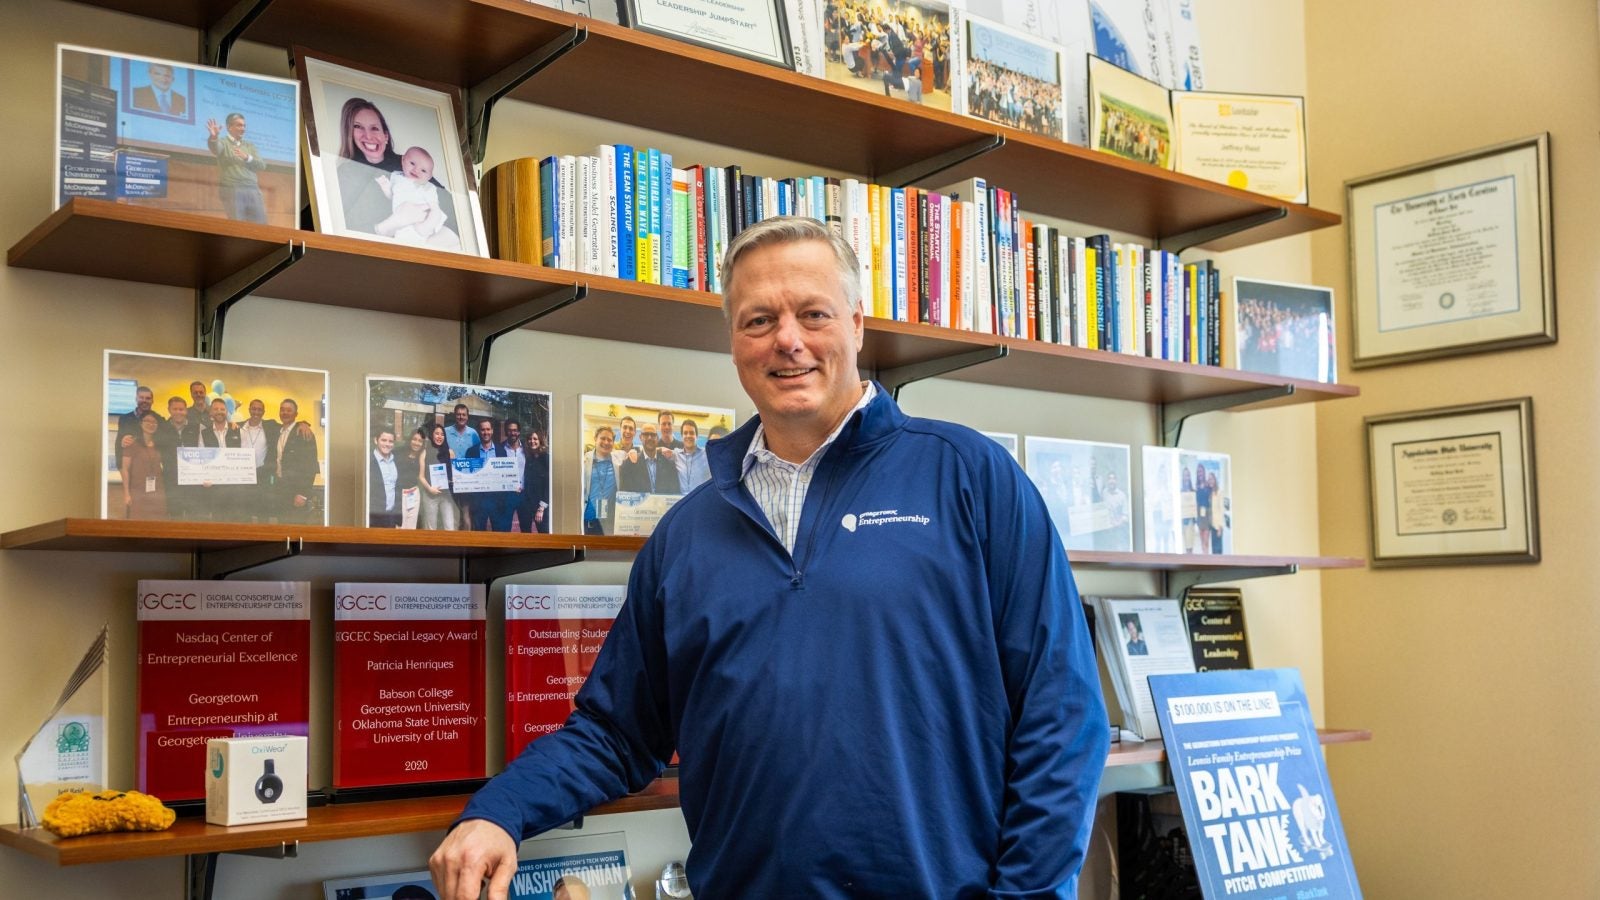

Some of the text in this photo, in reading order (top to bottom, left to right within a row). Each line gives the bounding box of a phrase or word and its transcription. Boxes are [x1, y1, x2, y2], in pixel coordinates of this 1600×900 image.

[657, 0, 707, 16] LEADERSHIP
[794, 46, 802, 66] 2013
[1189, 45, 1202, 89] carta
[64, 165, 106, 173] GEORGETOWN
[651, 176, 659, 201] THIRD
[1405, 200, 1438, 212] University
[1469, 186, 1498, 197] Carolina
[896, 196, 904, 221] START-UP
[924, 257, 928, 265] OF
[1402, 449, 1438, 458] Appalachian
[1459, 443, 1492, 451] University
[859, 515, 930, 526] Entrepreneurship
[143, 593, 196, 610] GCEC
[341, 595, 386, 611] GCEC
[511, 596, 551, 610] GCEC
[1186, 599, 1205, 611] GCEC
[176, 632, 273, 644] Nasdaq Center of
[341, 630, 478, 644] GCEC Special Legacy Award
[529, 629, 580, 640] Outstanding
[518, 645, 579, 656] Engagement &
[1203, 648, 1239, 660] Leadership
[148, 652, 298, 665] Entrepreneurial Excellence
[367, 660, 454, 672] Patricia Henriques
[189, 693, 258, 705] Georgetown
[380, 688, 454, 700] Babson College
[360, 702, 471, 716] Georgetown University
[1174, 703, 1212, 717] $100,000
[1214, 703, 1223, 713] IS
[1224, 701, 1236, 713] ON
[1237, 700, 1253, 711] THE
[168, 711, 278, 726] Entrepreneurship at
[352, 716, 478, 730] Oklahoma State University
[373, 730, 459, 744] University of Utah
[252, 745, 285, 754] OxiWear
[1188, 746, 1302, 767] Leonsis Family Entrepreneurship Prize
[405, 760, 428, 771] 2020
[1190, 762, 1291, 822] BARK
[1203, 814, 1303, 875] TANK
[544, 859, 586, 868] WASHINGTON'S
[1224, 863, 1324, 895] PITCH COMPETITION
